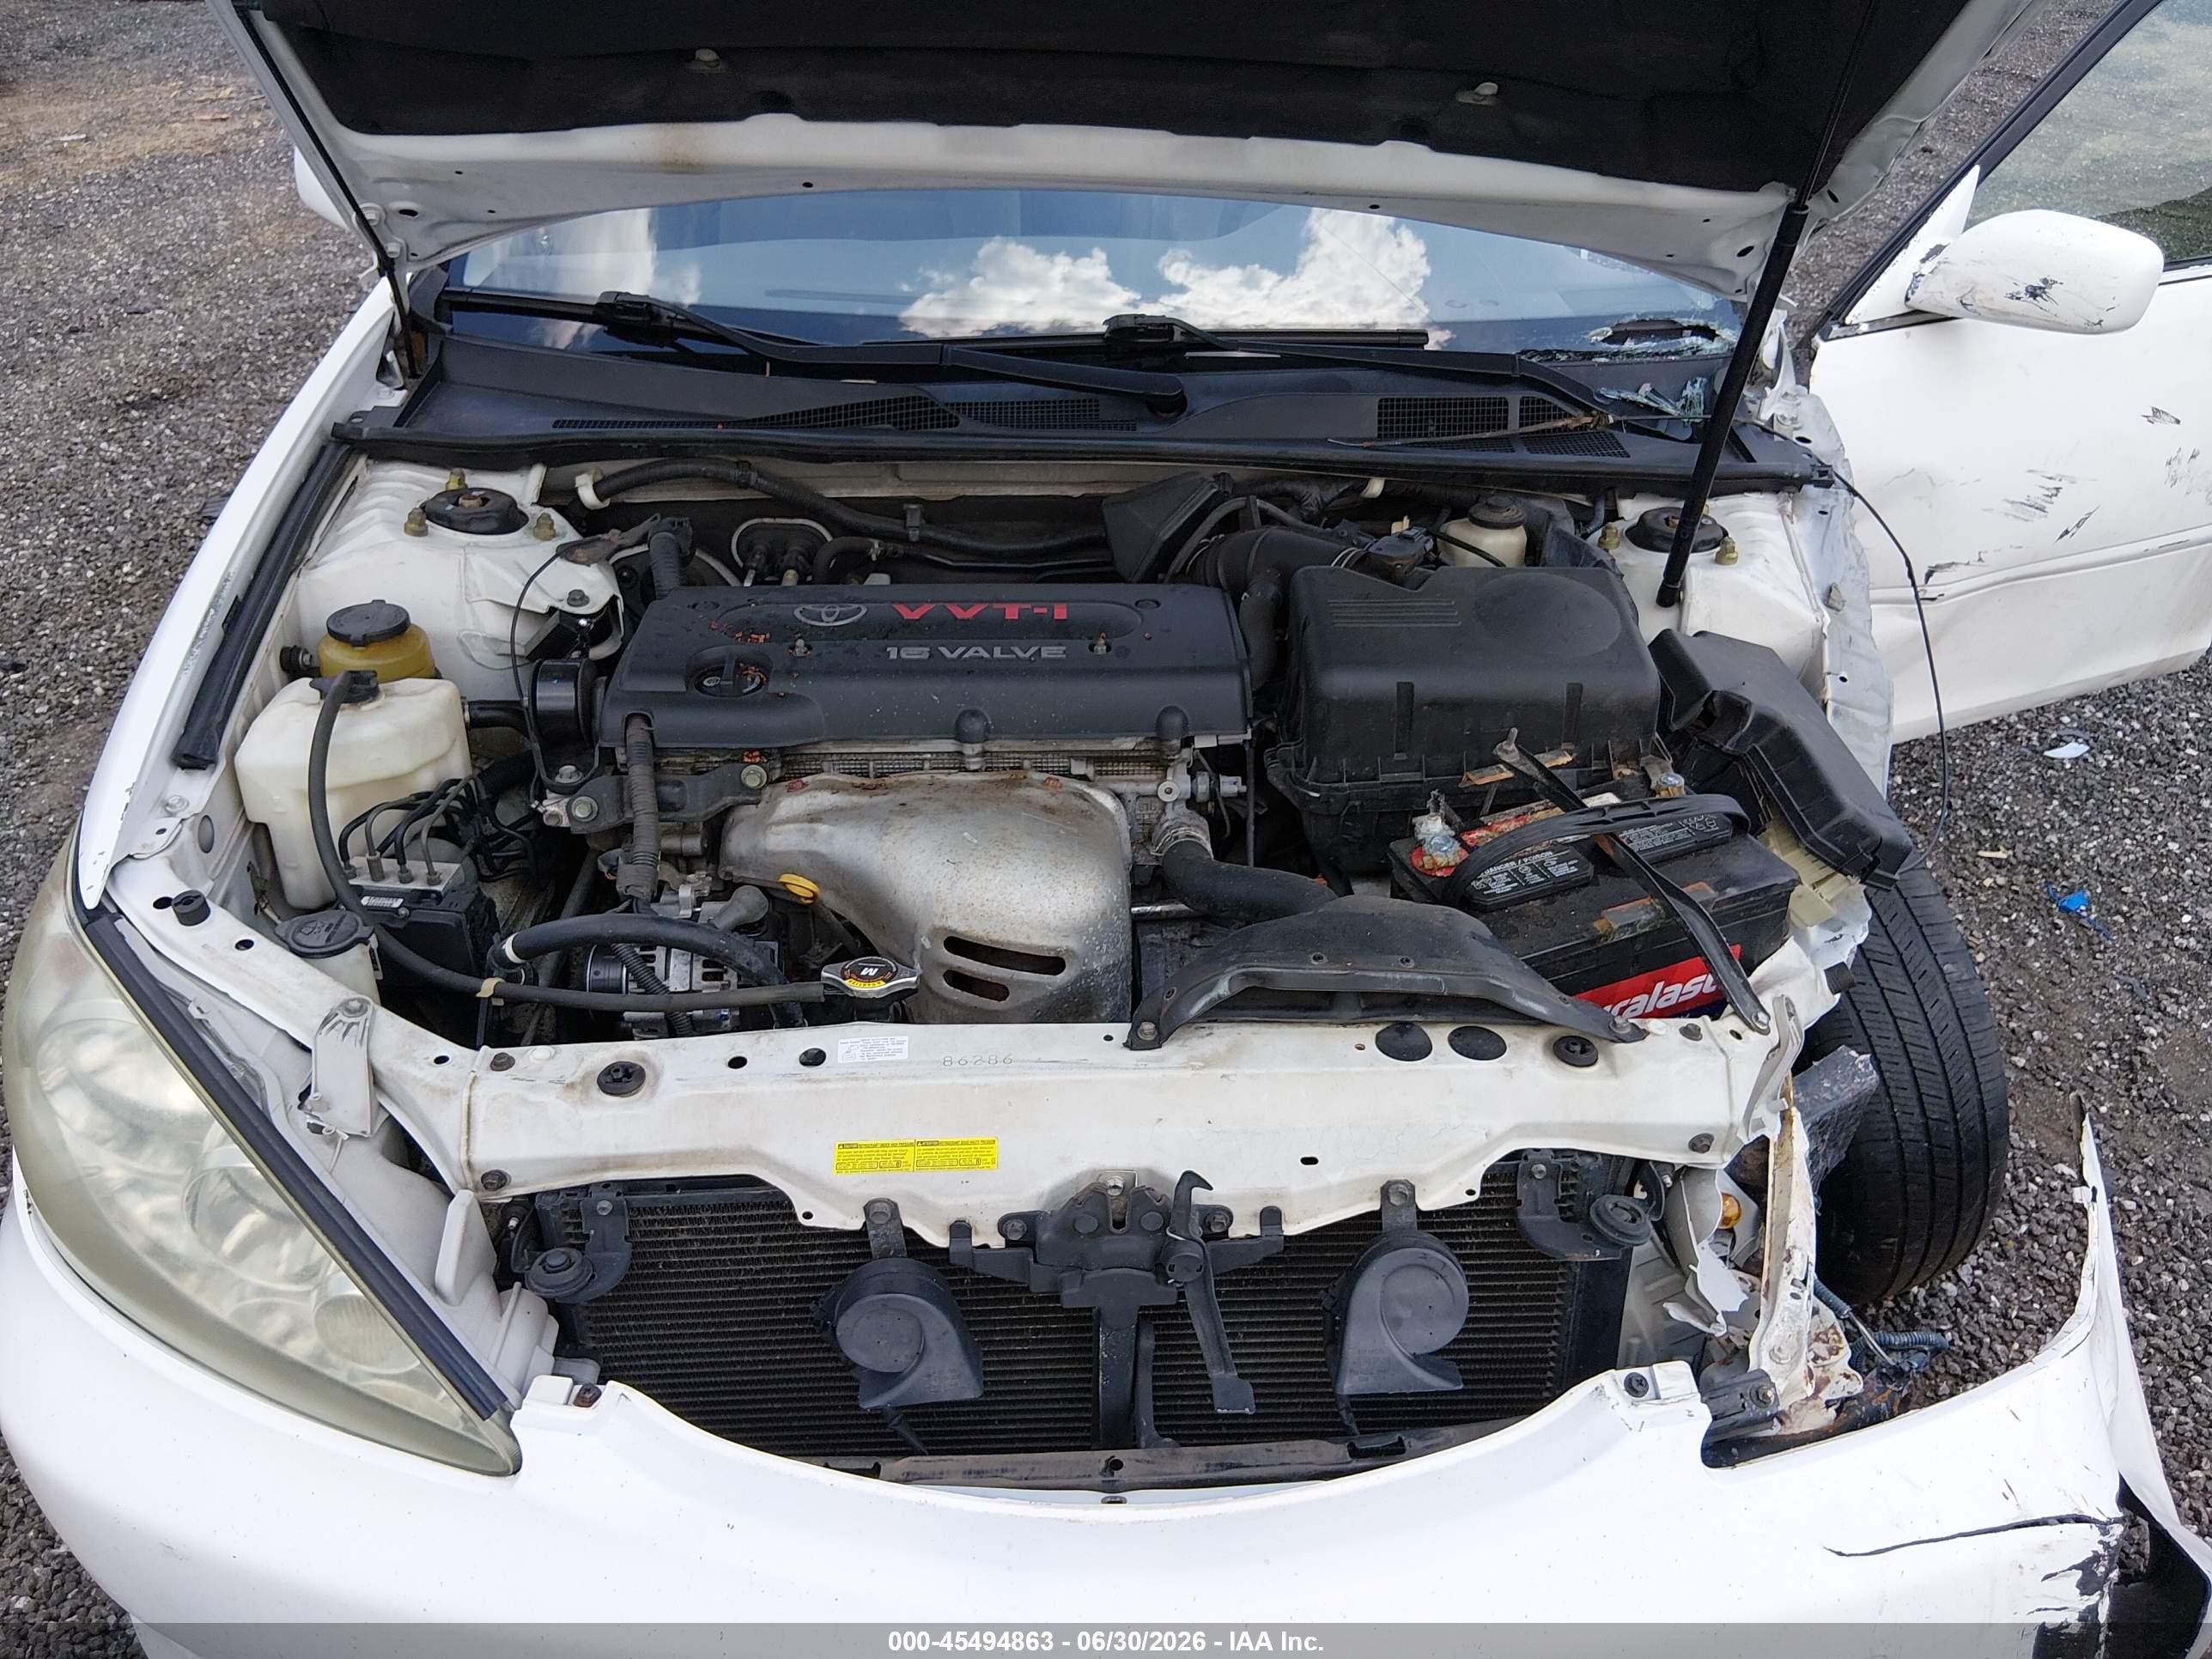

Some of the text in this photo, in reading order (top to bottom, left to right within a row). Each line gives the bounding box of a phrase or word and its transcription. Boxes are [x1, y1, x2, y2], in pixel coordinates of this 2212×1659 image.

[886, 646, 1066, 659] 16 VALVE
[1603, 973, 1717, 1020] ralast
[943, 1053, 1012, 1066] 86286
